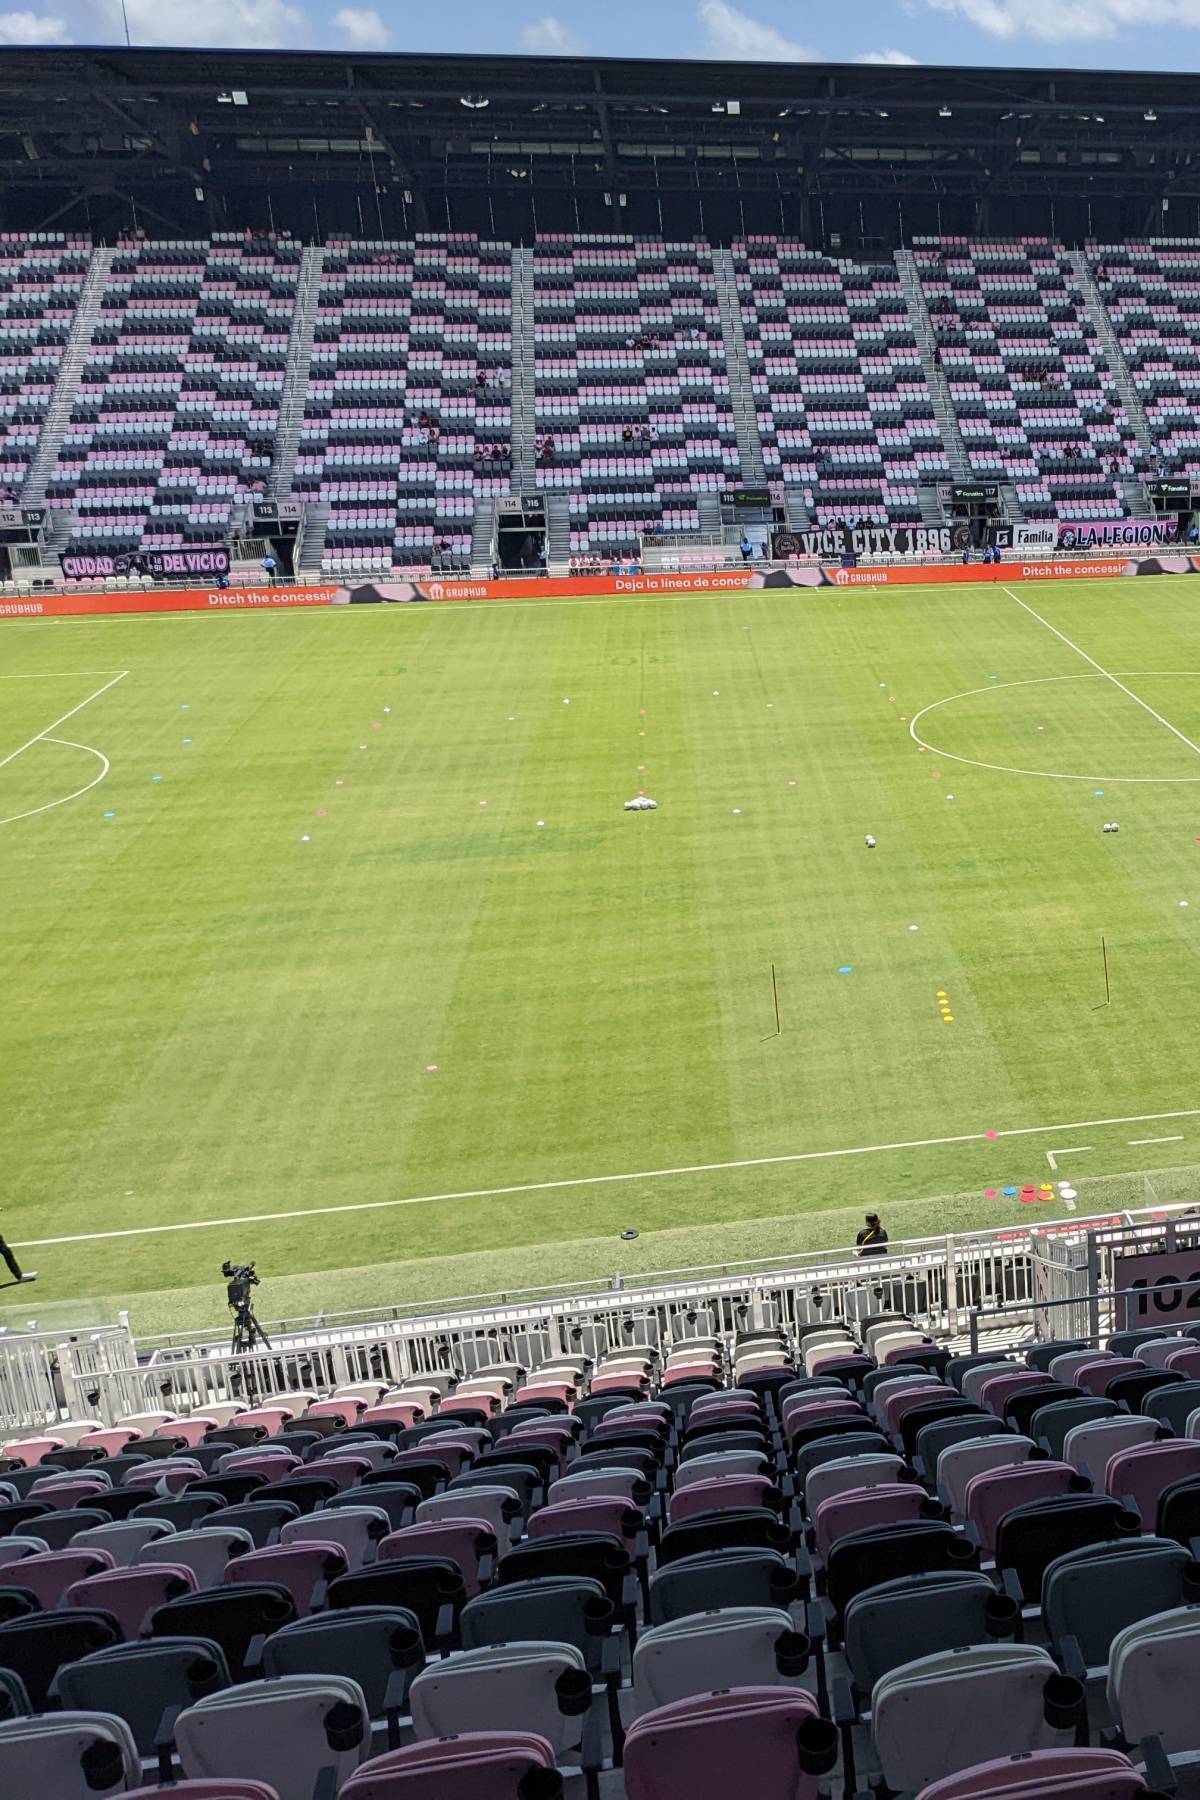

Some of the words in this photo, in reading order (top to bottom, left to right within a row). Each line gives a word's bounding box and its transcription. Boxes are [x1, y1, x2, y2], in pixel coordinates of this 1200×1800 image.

[283, 505, 297, 513] 114
[504, 500, 517, 508] 114
[259, 506, 273, 514] 113
[2, 514, 16, 522] 112
[27, 513, 41, 521] 113
[1018, 528, 1054, 544] Familia
[1076, 526, 1098, 546] LA
[1104, 524, 1166, 544] LEGION
[801, 530, 847, 554] VICE
[852, 529, 898, 554] CITY
[905, 528, 951, 552] 1896
[64, 556, 115, 575] CIUDAD
[1022, 566, 1052, 576] Ditch
[1054, 564, 1072, 575] the
[850, 574, 888, 583] GRUBHUB
[615, 580, 644, 592] Deja
[646, 579, 658, 589] la
[662, 578, 688, 588] línea
[690, 577, 710, 588] de
[446, 588, 487, 597] GRUBHUB
[208, 594, 245, 605] Ditch
[248, 592, 270, 603] the
[0, 604, 44, 614] GRUBHUB
